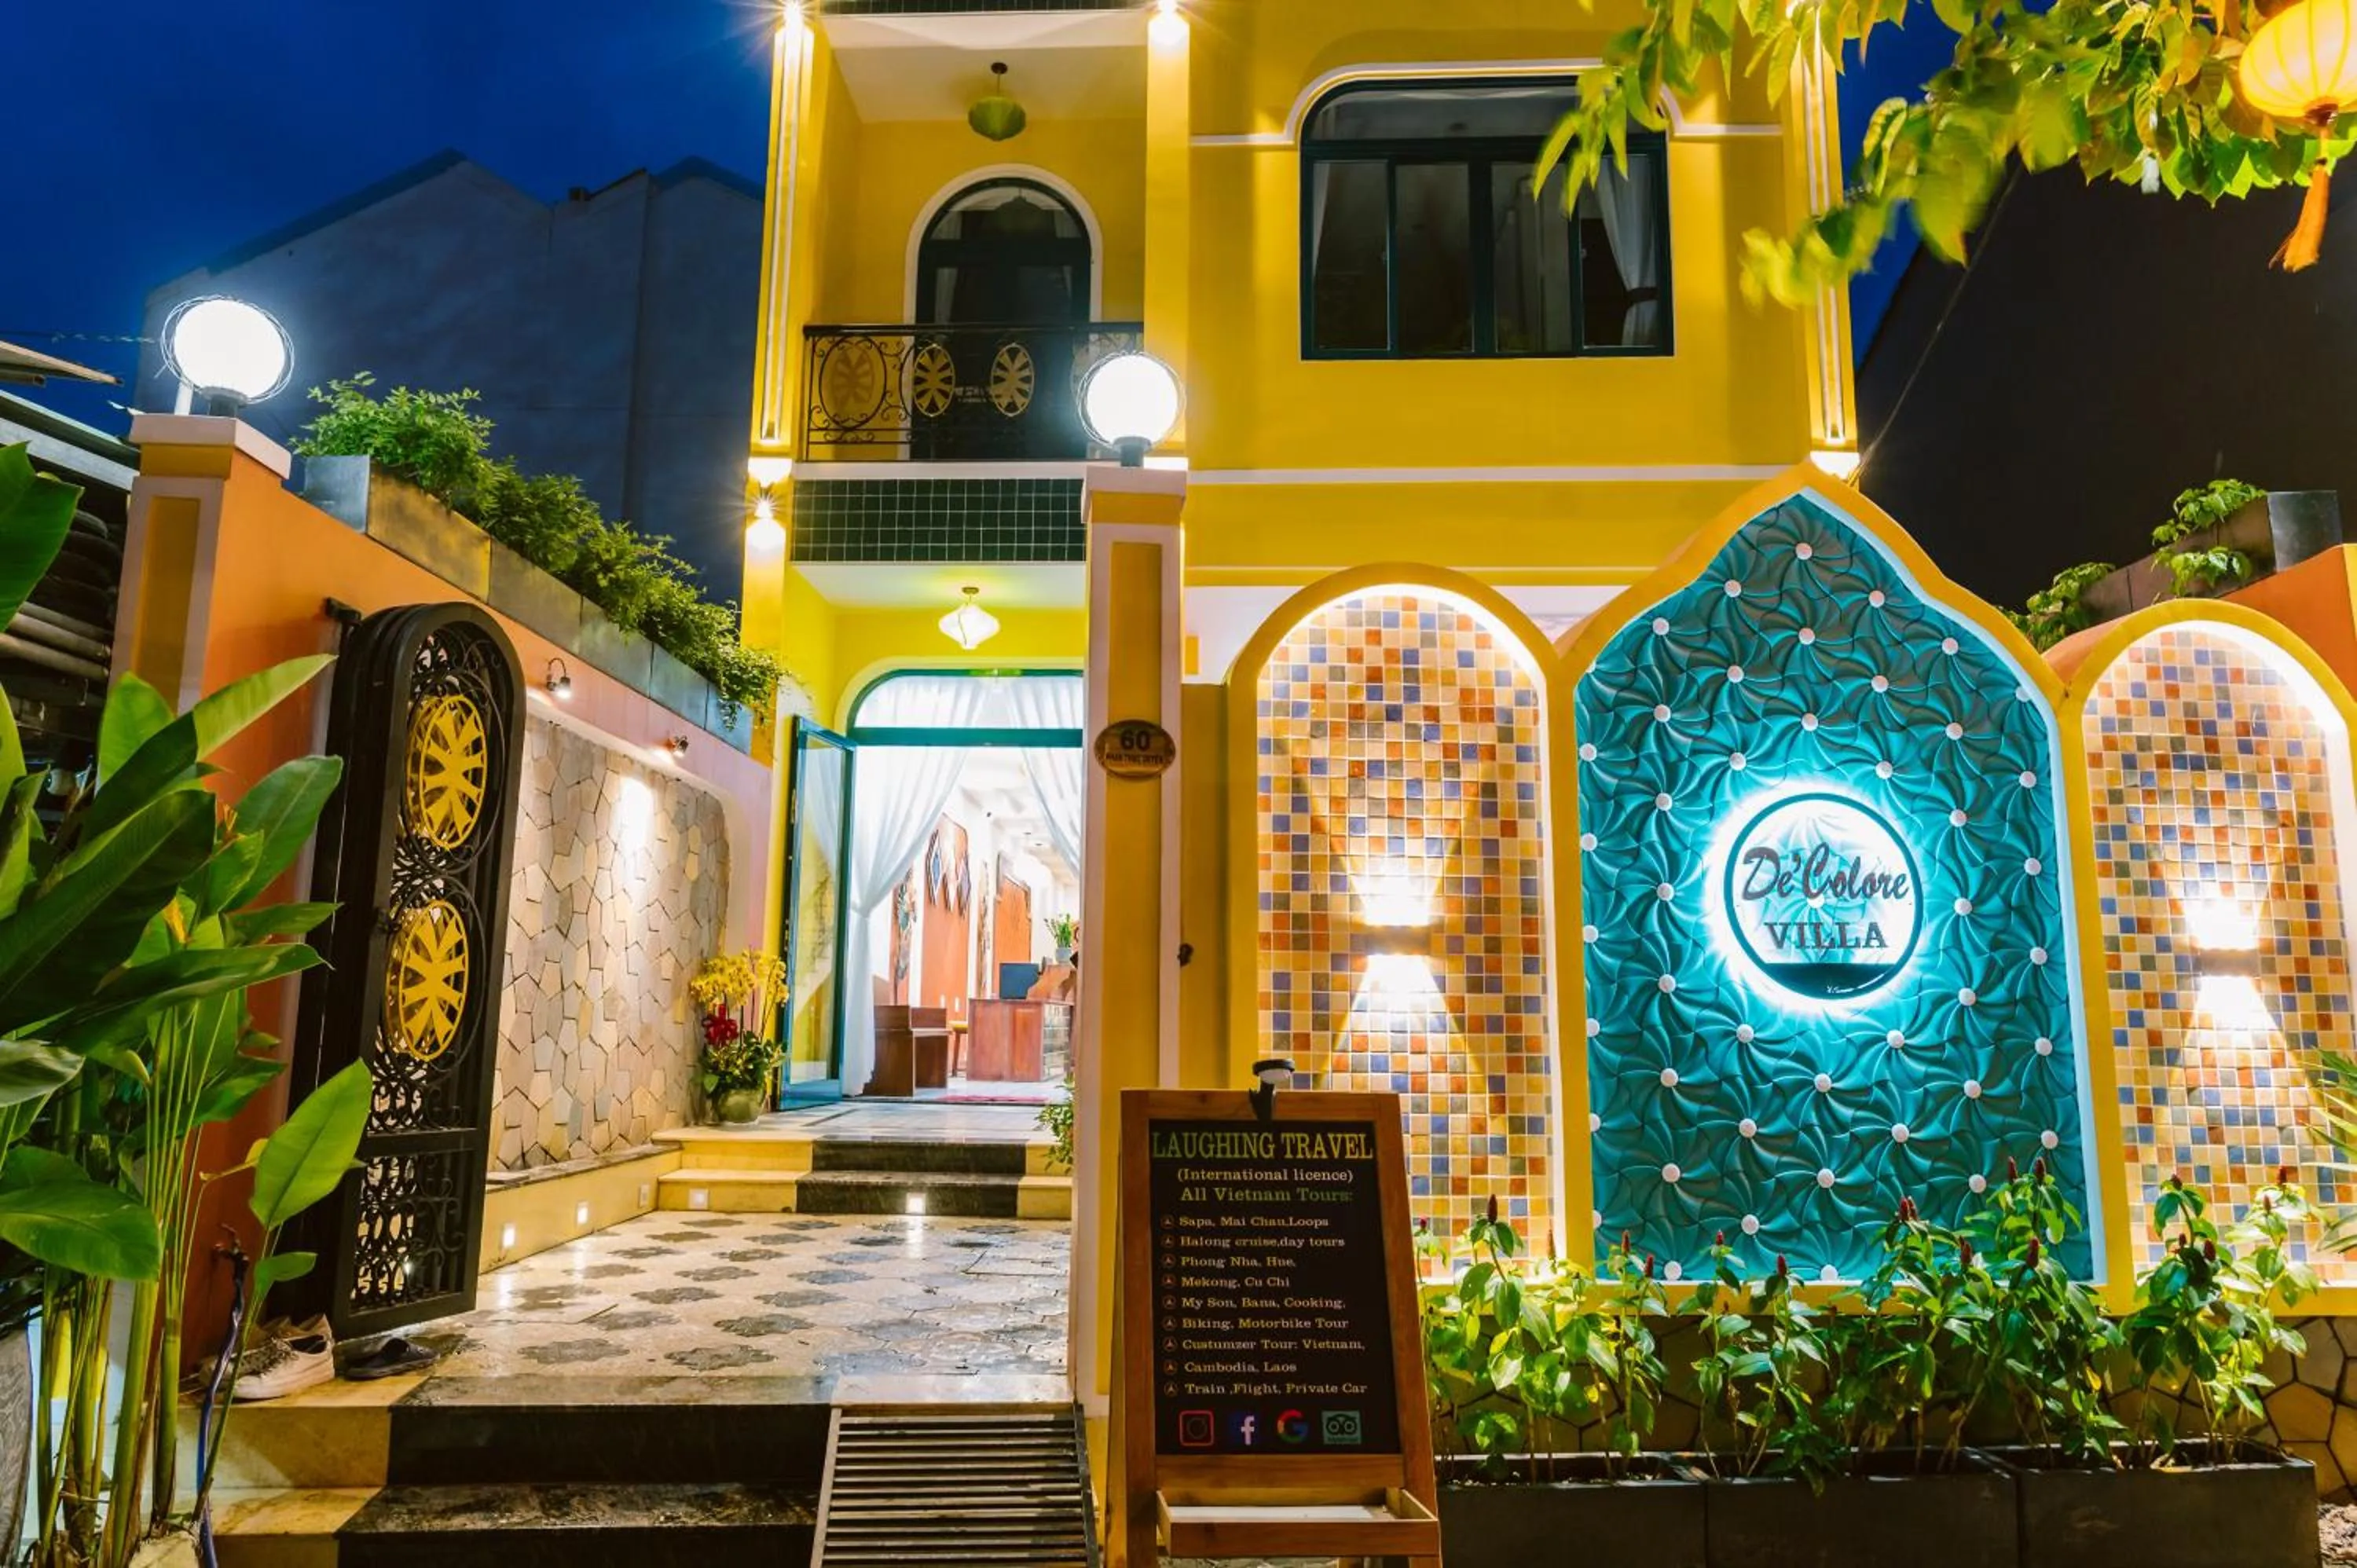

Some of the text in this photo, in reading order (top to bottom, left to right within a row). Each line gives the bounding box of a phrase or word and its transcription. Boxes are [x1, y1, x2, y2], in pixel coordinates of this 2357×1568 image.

[1764, 922, 1888, 949] VILLA
[1152, 1132, 1373, 1159] LAUGHING TRAVEL
[1178, 1168, 1288, 1182] (International
[1181, 1187, 1207, 1201] All
[1213, 1188, 1291, 1201] Vietnam
[1221, 1218, 1246, 1226] Mai
[1180, 1236, 1230, 1248] Halong
[1310, 1238, 1345, 1247] tours
[1181, 1257, 1225, 1268] Phong
[1266, 1277, 1289, 1286] Chi
[1182, 1298, 1203, 1310] My
[1239, 1318, 1310, 1328] Motorbike
[1314, 1318, 1349, 1328] Tour
[1264, 1363, 1296, 1372] Laos
[1185, 1383, 1225, 1394] Train
[1285, 1383, 1338, 1394] Private
[1342, 1383, 1368, 1394] Car
